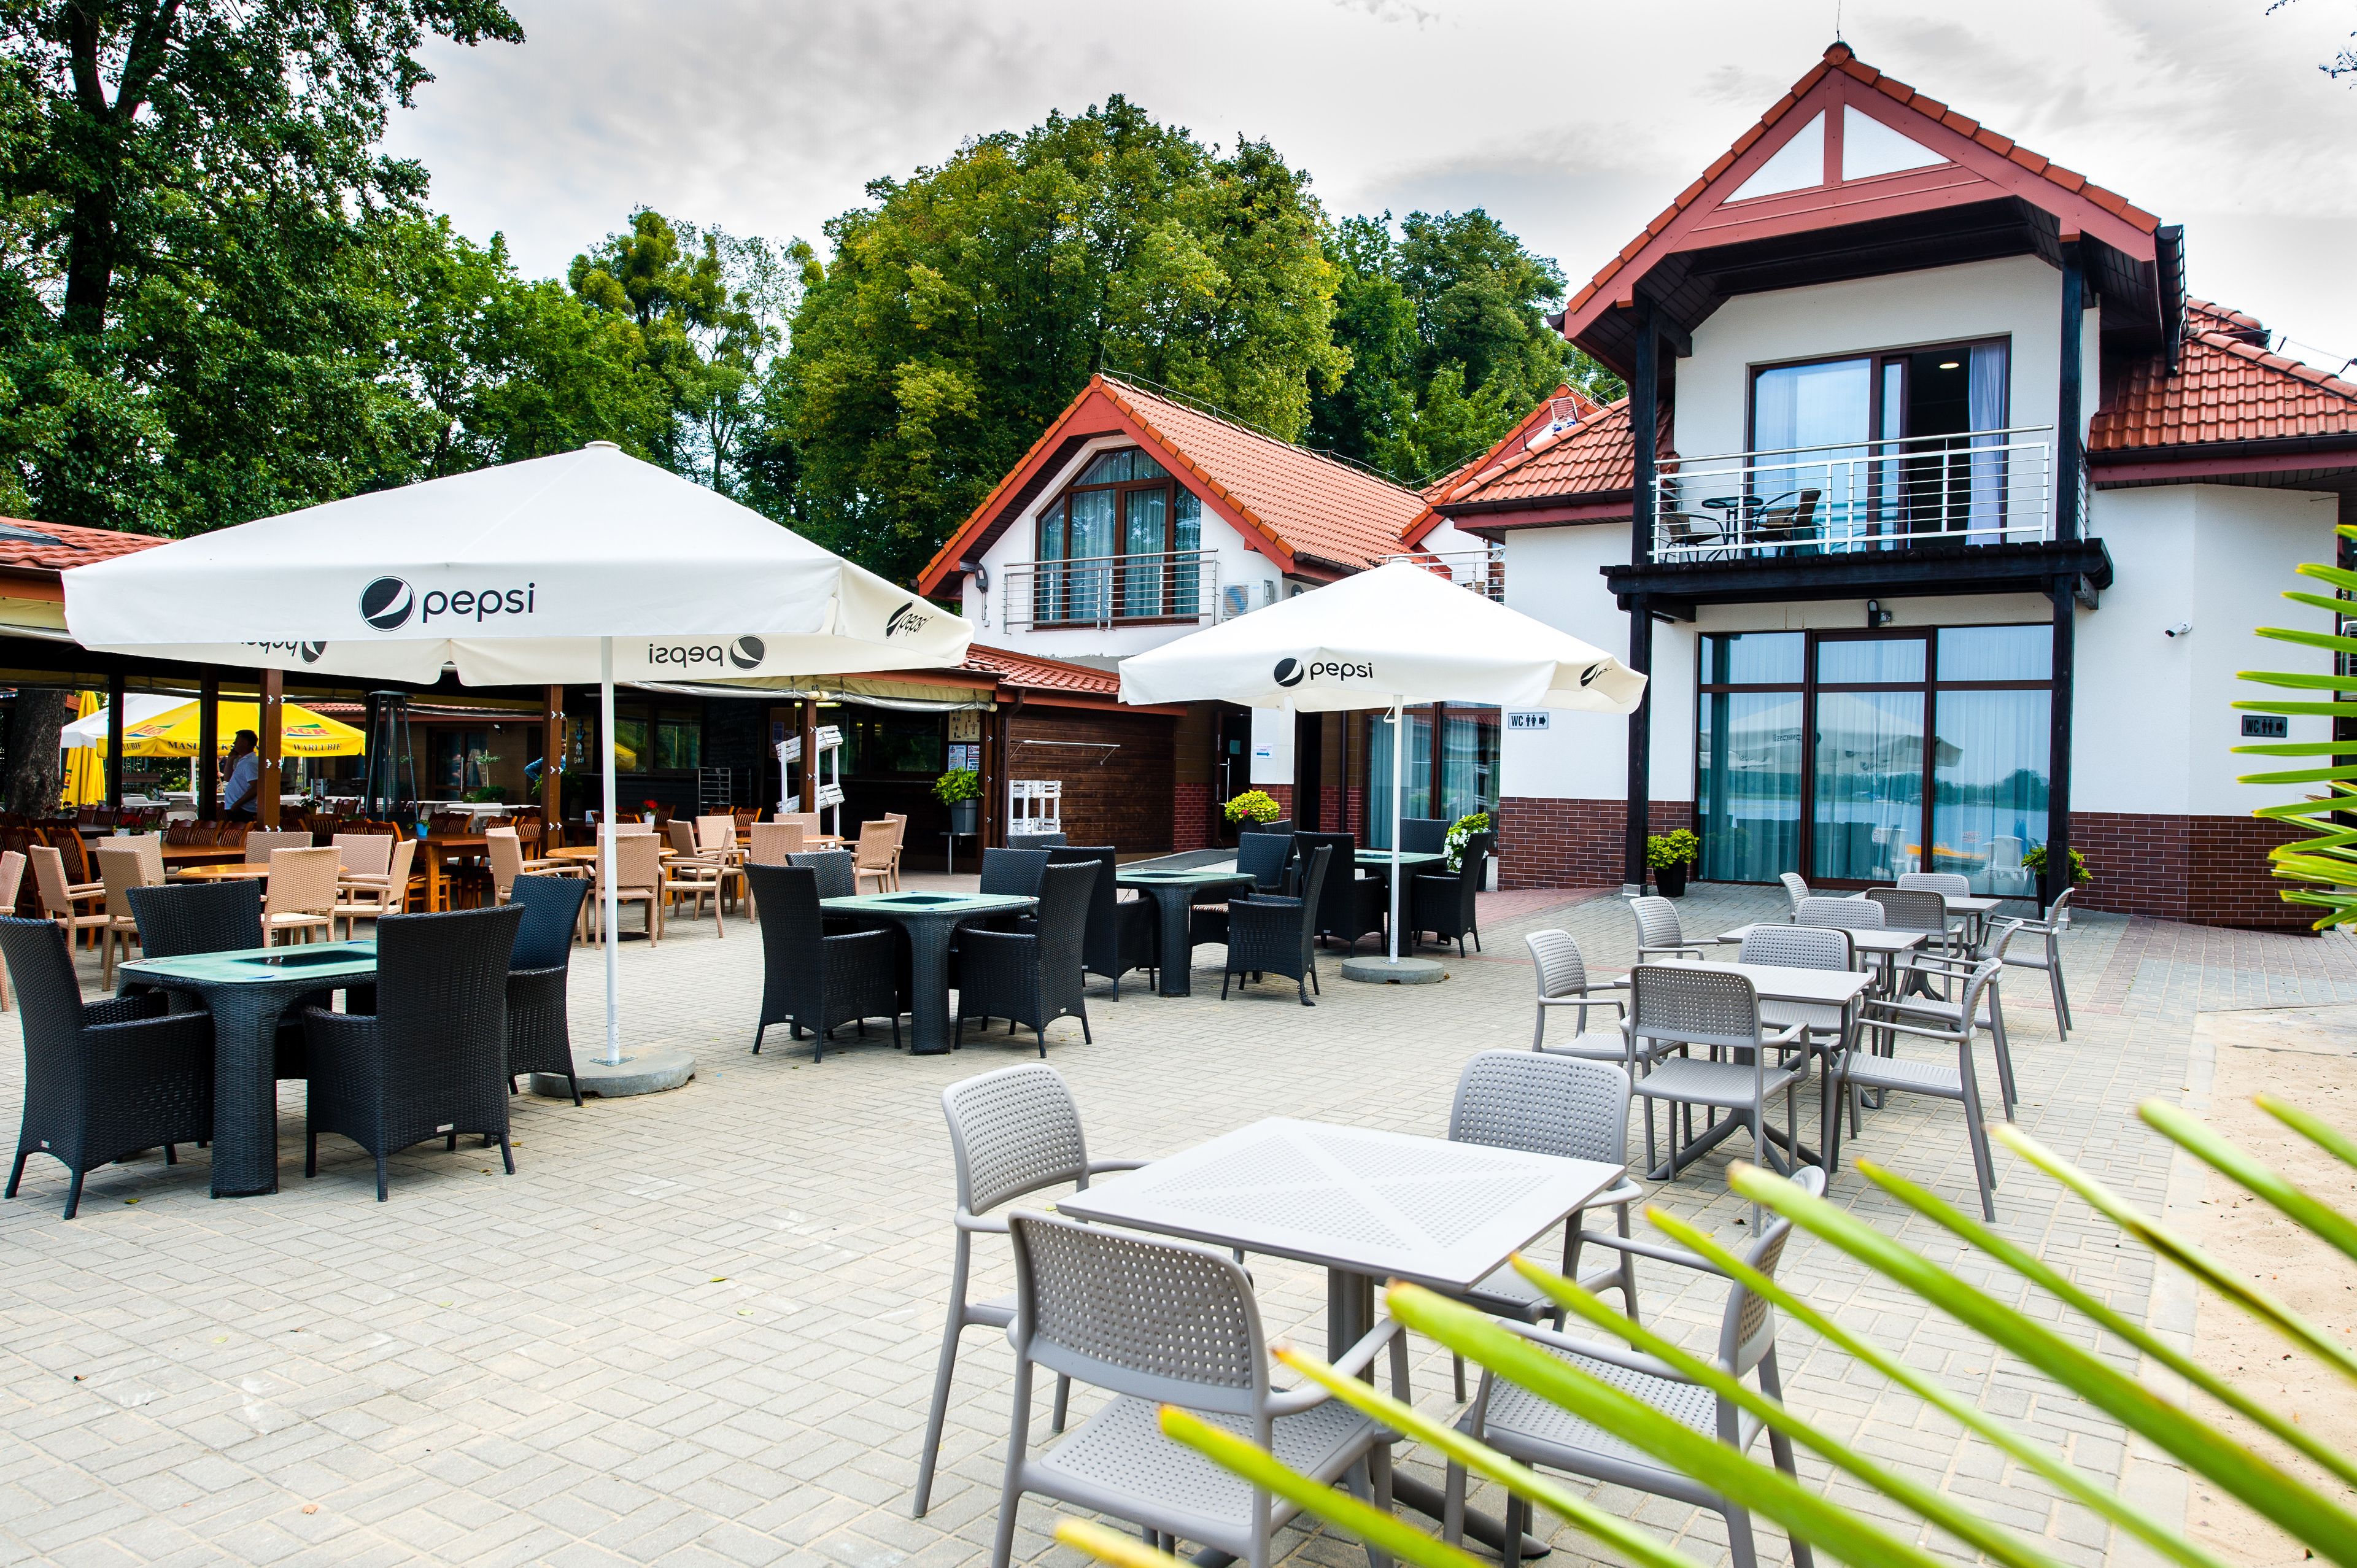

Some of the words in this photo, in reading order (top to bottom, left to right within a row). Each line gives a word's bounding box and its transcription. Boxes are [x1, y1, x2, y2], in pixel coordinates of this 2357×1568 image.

[422, 582, 535, 624] pepsi
[896, 612, 934, 637] pepsi
[1309, 662, 1373, 681] pepsi
[1511, 715, 1523, 727] WC
[2245, 719, 2259, 733] WC
[293, 743, 343, 751] WARLUBIE
